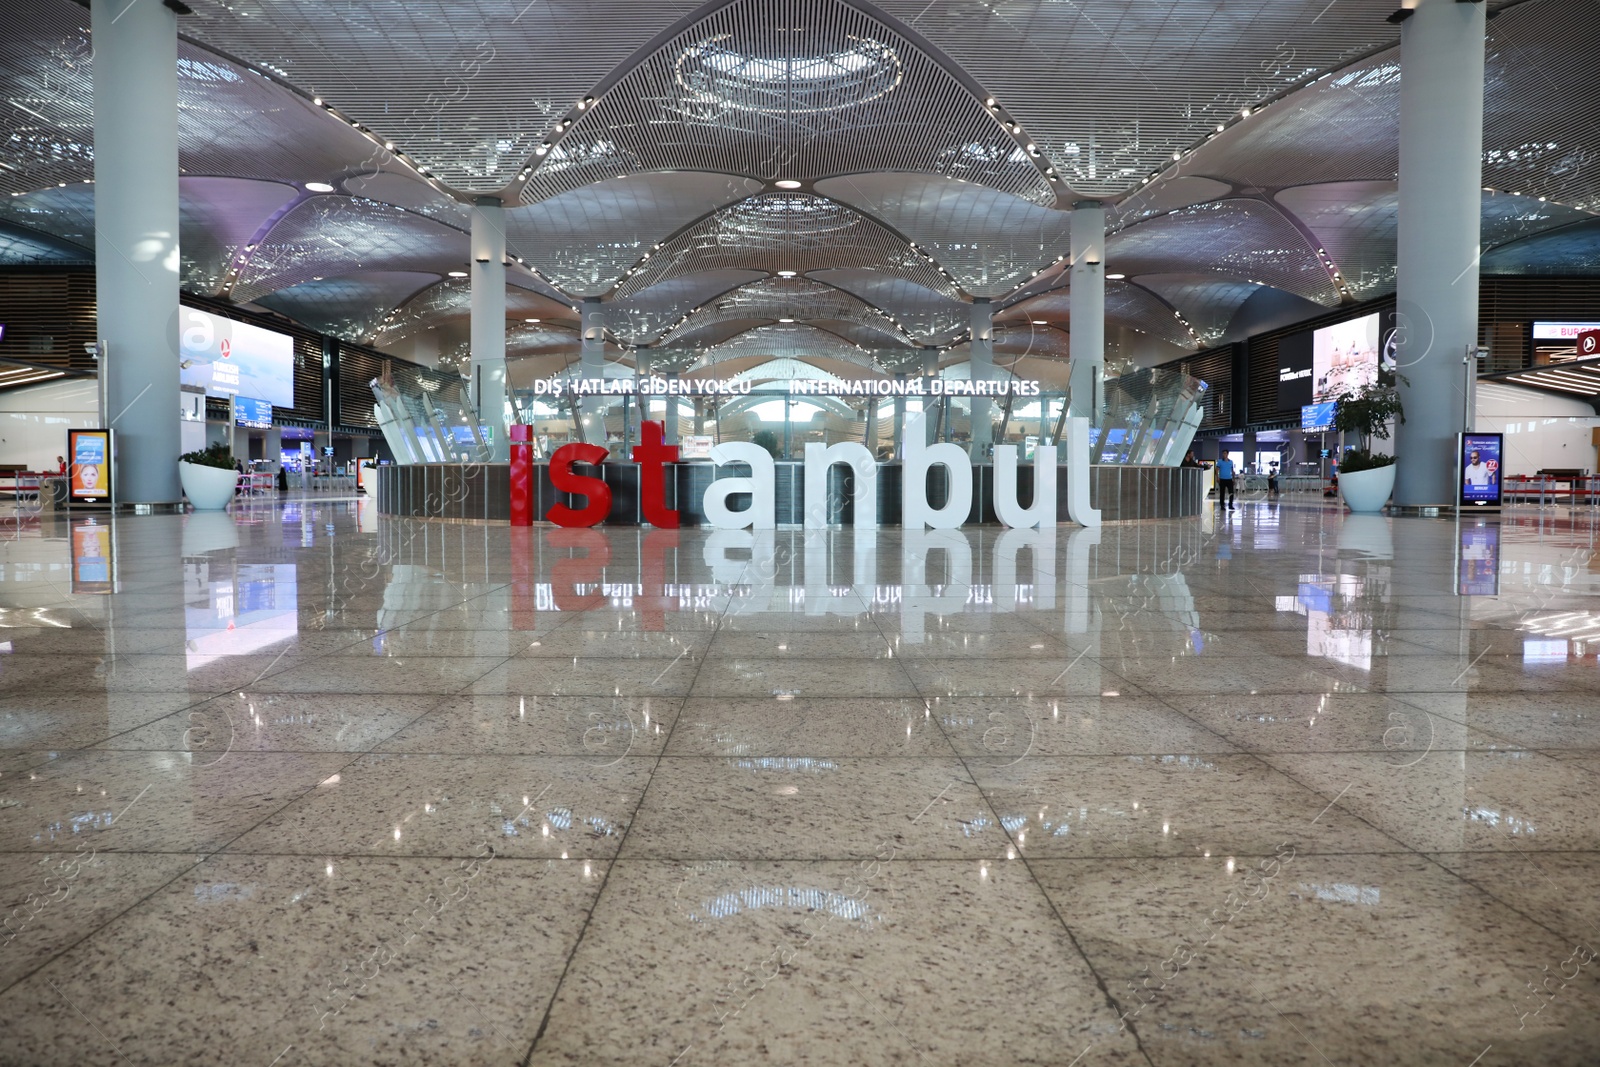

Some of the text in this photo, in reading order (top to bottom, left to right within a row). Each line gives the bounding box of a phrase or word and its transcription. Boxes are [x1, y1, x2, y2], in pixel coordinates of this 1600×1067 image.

[534, 375, 752, 397] DIŞ HATLAR GİDEN YOLCU
[789, 378, 1040, 396] INTERNATIONAL DEPARTURES
[510, 412, 1102, 529] istanbul
